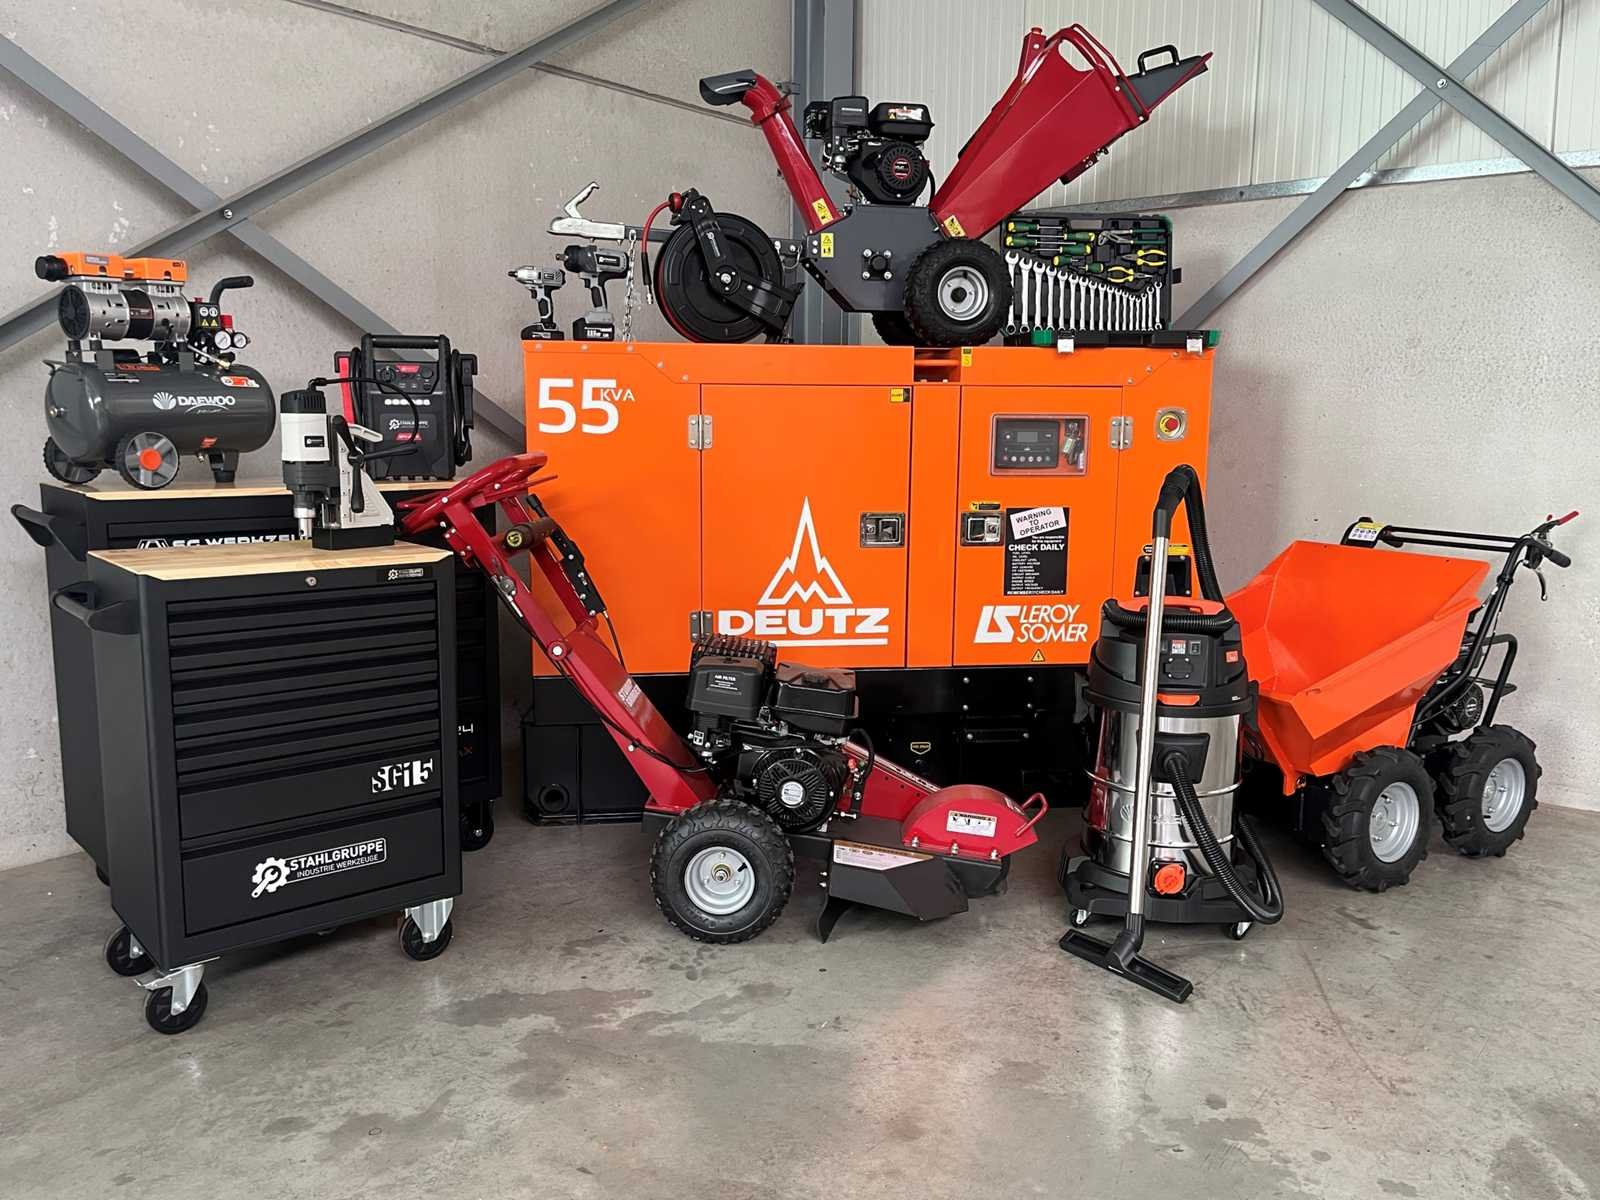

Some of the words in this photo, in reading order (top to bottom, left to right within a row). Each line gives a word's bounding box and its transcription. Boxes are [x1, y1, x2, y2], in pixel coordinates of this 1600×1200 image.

[177, 396, 236, 406] DAEWOO
[538, 378, 620, 434] 55
[600, 388, 635, 401] KVA
[1015, 508, 1052, 523] WARNING
[1019, 519, 1061, 536] OPERATOR
[718, 608, 890, 636] DEUTZ
[1019, 604, 1080, 624] LEROY
[1016, 623, 1089, 643] SOMER
[290, 840, 384, 871] STAHLGRUPPE
[296, 863, 335, 878] INDUSTRIE
[336, 854, 379, 869] WERKZEUGE
